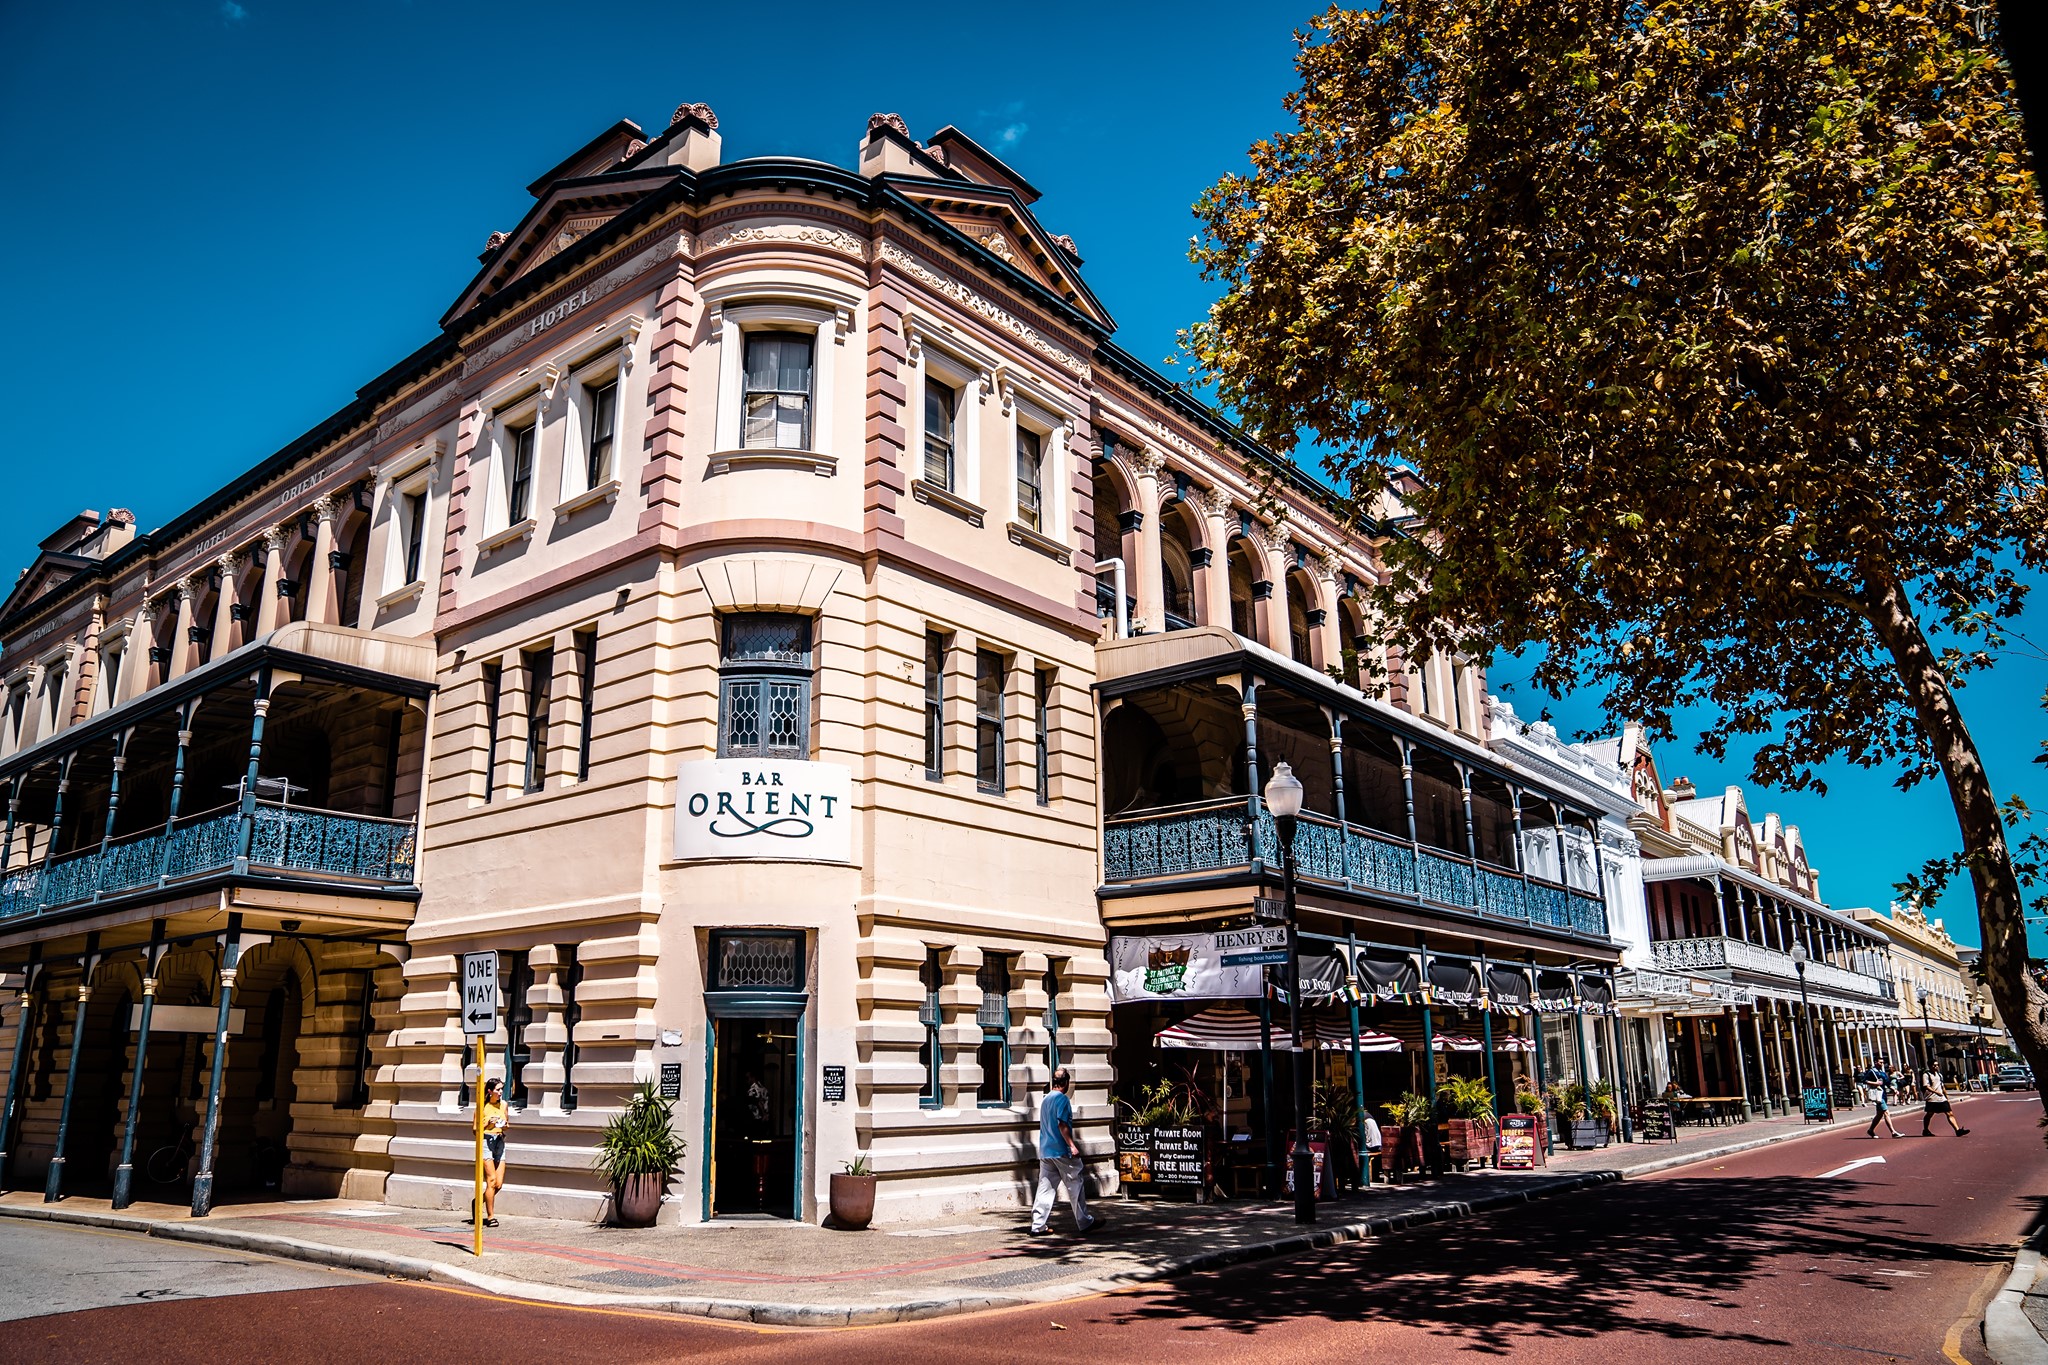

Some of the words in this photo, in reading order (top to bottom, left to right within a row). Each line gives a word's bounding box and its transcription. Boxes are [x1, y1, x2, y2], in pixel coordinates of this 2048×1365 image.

[531, 290, 594, 337] HOTEL
[195, 529, 228, 555] HOTEL
[281, 470, 325, 504] ORIENT
[742, 772, 783, 786] BAR
[689, 791, 838, 837] ORIENT
[1255, 899, 1277, 915] HIGH
[1216, 930, 1265, 947] HENRY
[1266, 930, 1275, 938] ST
[468, 959, 492, 978] ONE
[468, 984, 493, 1003] WAY
[1802, 1088, 1826, 1099] HIGH
[1118, 1133, 1150, 1145] ORIENT
[1154, 1161, 1177, 1171] FREE
[1179, 1161, 1202, 1172] HIRE
